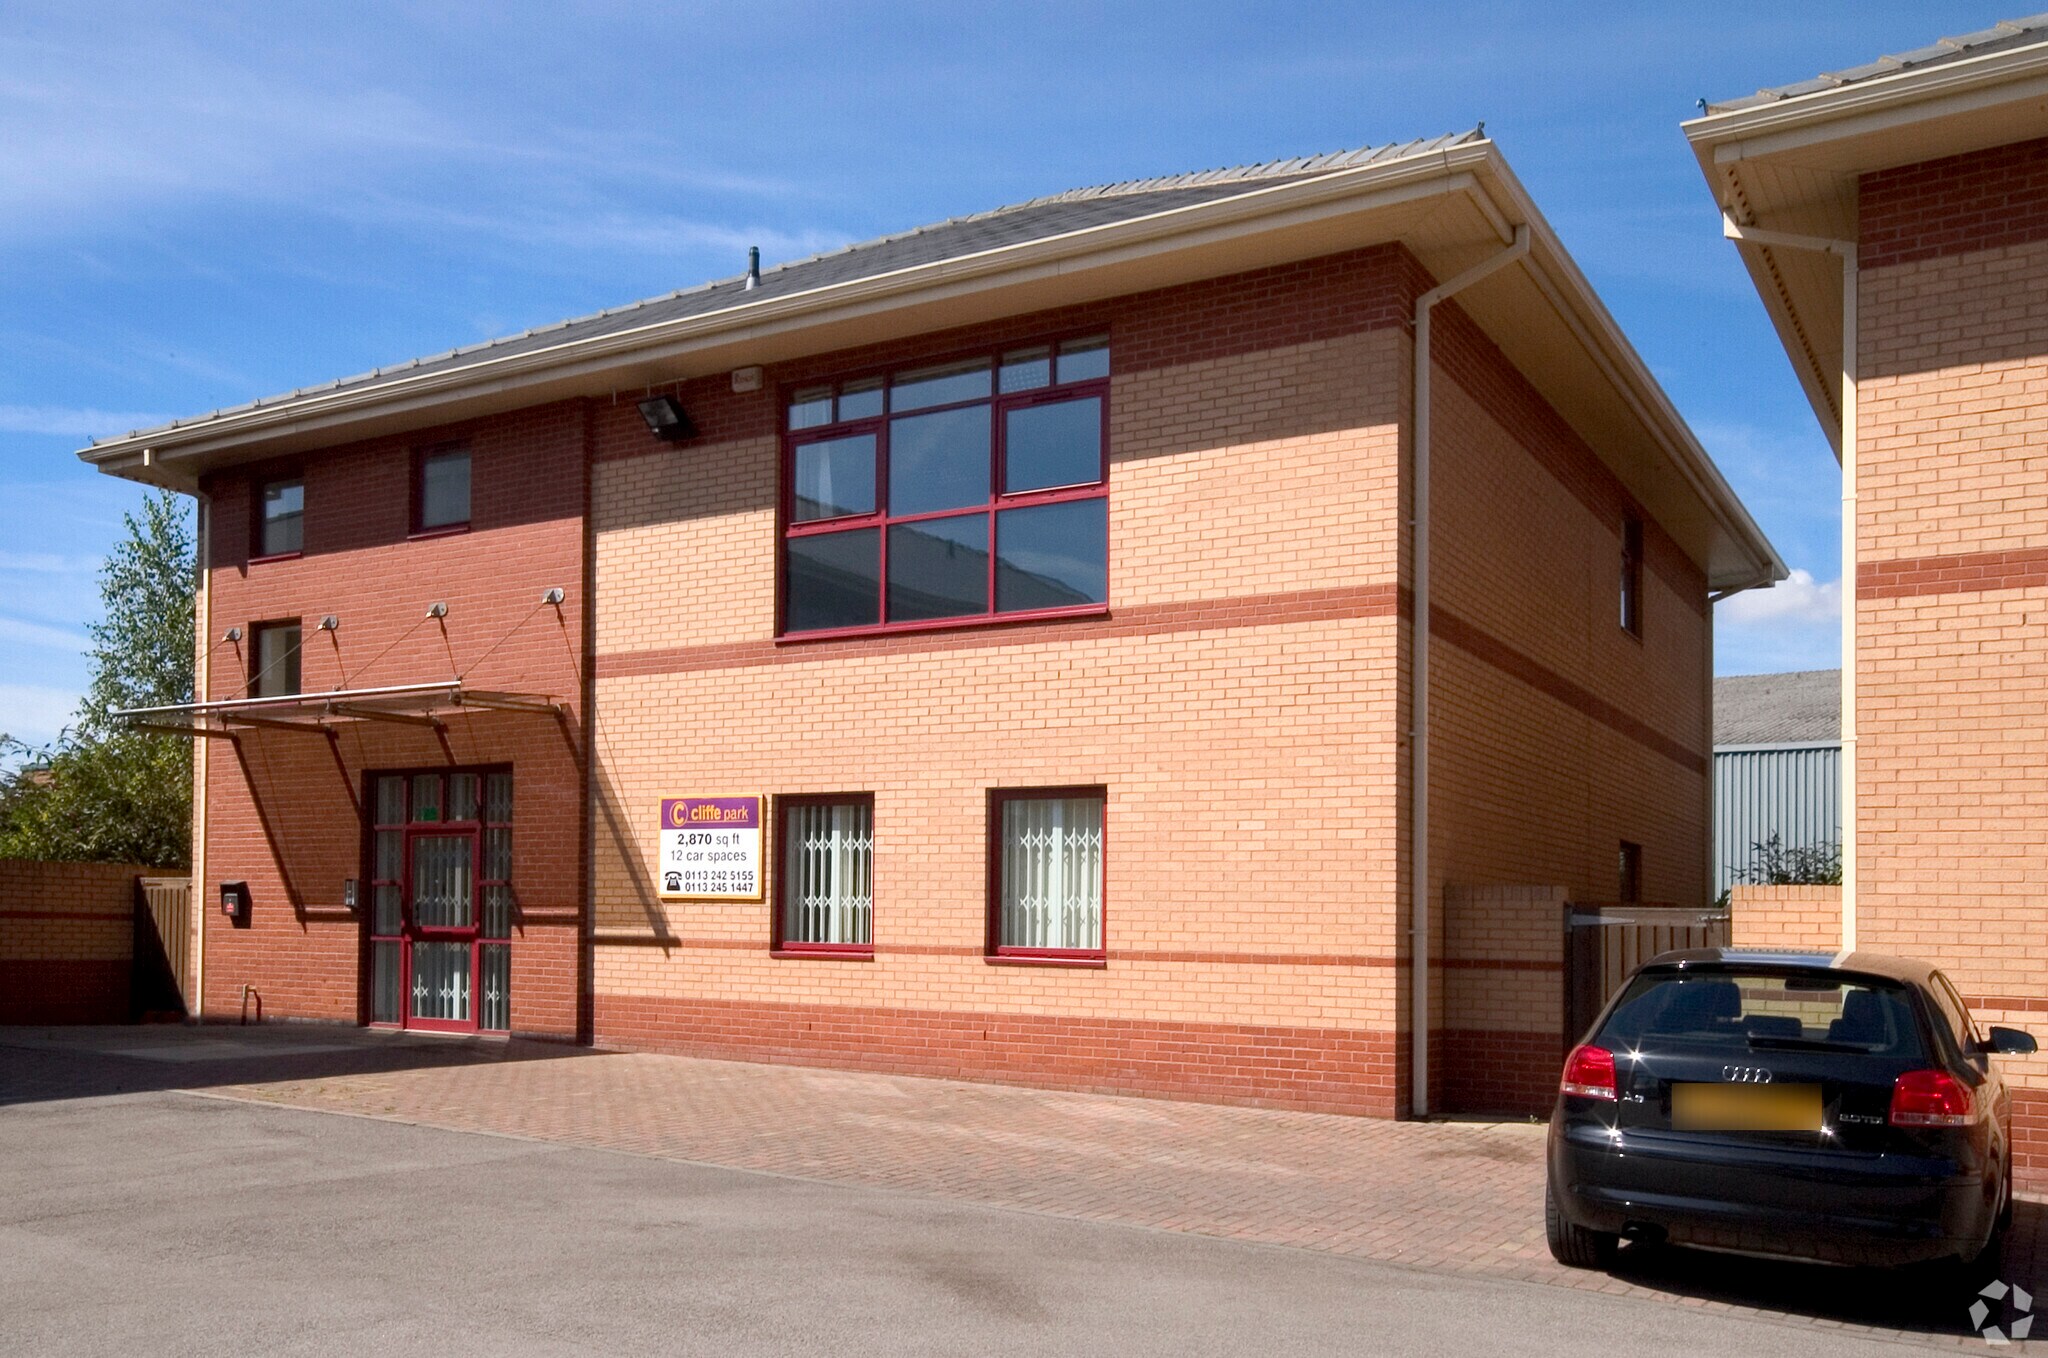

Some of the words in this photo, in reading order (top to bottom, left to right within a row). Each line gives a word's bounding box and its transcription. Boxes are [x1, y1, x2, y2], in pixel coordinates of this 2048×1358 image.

[691, 805, 721, 820] cliffe
[724, 806, 749, 821] park
[677, 833, 712, 847] 2,870
[716, 835, 729, 847] sq
[732, 833, 740, 845] ft
[671, 850, 683, 861] 12
[686, 851, 704, 861] car
[707, 851, 747, 864] spaces
[685, 871, 708, 880] 0113
[711, 871, 727, 880] 242
[730, 871, 754, 880] 5155
[685, 883, 708, 892] 0113
[711, 883, 727, 892] 245
[731, 883, 753, 892] 1447
